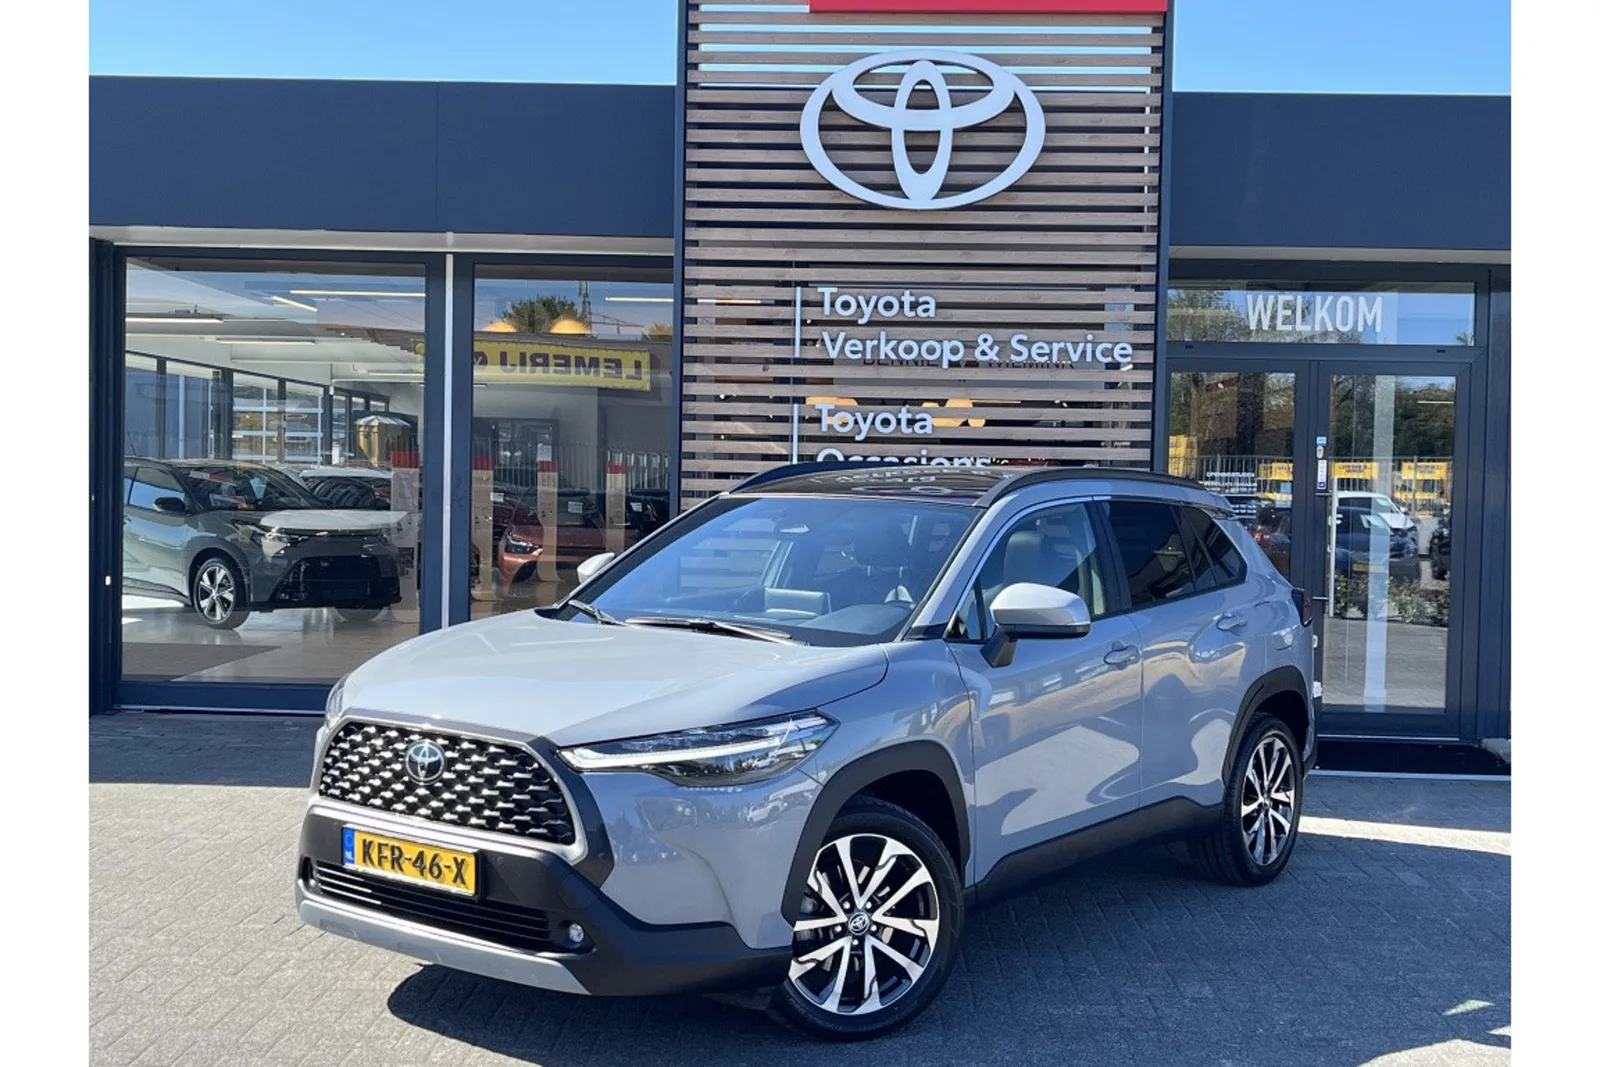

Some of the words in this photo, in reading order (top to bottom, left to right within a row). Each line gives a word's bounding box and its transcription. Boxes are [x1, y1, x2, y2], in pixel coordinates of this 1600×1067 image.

[817, 287, 937, 325] Toyota
[1246, 294, 1383, 333] WELKOM
[821, 331, 965, 369] Verkoop
[973, 333, 998, 361] &
[1010, 333, 1133, 364] Service
[815, 404, 933, 440] Toyota
[362, 838, 467, 886] KFR-46-X
